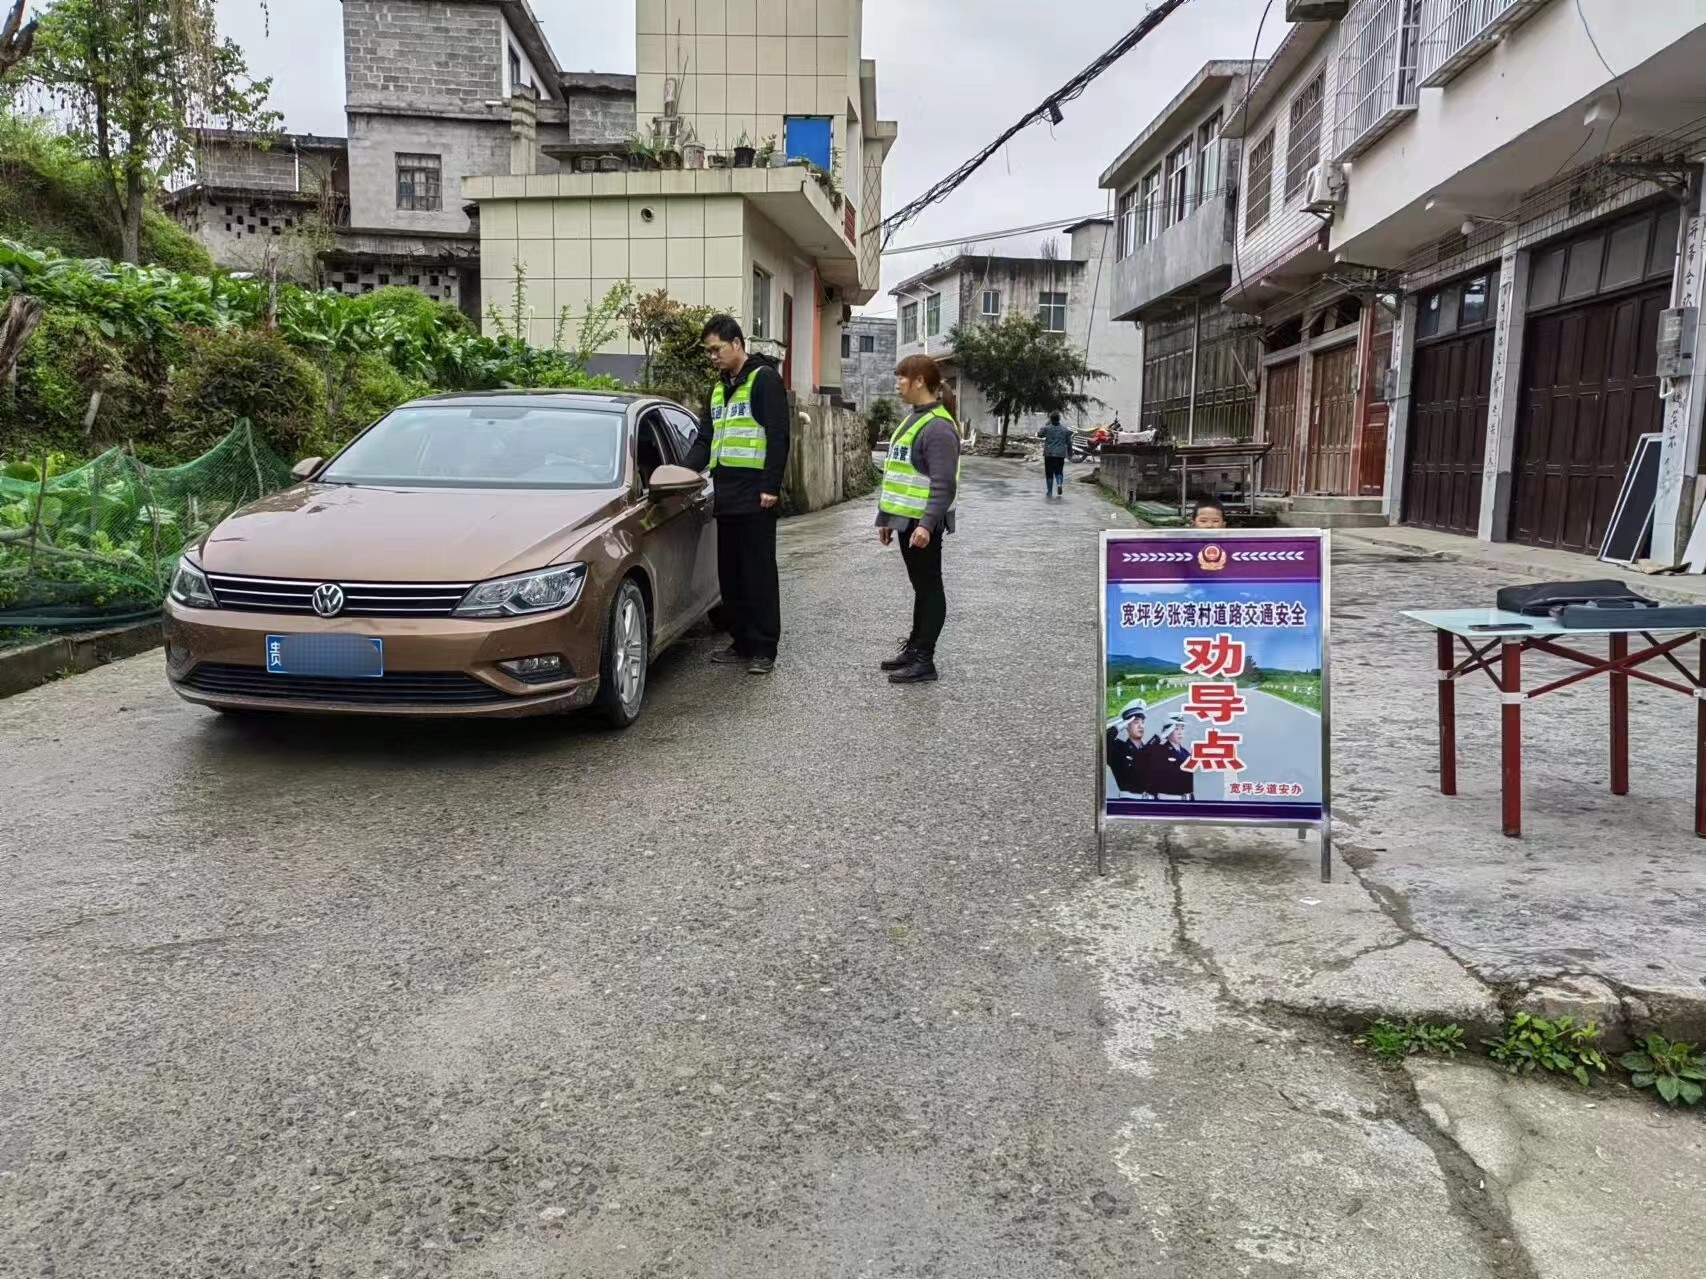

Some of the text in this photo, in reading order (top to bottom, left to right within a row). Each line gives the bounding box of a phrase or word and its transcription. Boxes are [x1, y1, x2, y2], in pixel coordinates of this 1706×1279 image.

[1121, 601, 1307, 627] 宽坪乡张湾村道路交通安全
[1182, 633, 1246, 772] 劝导点
[1229, 782, 1303, 795] 宽坪乡道安办
